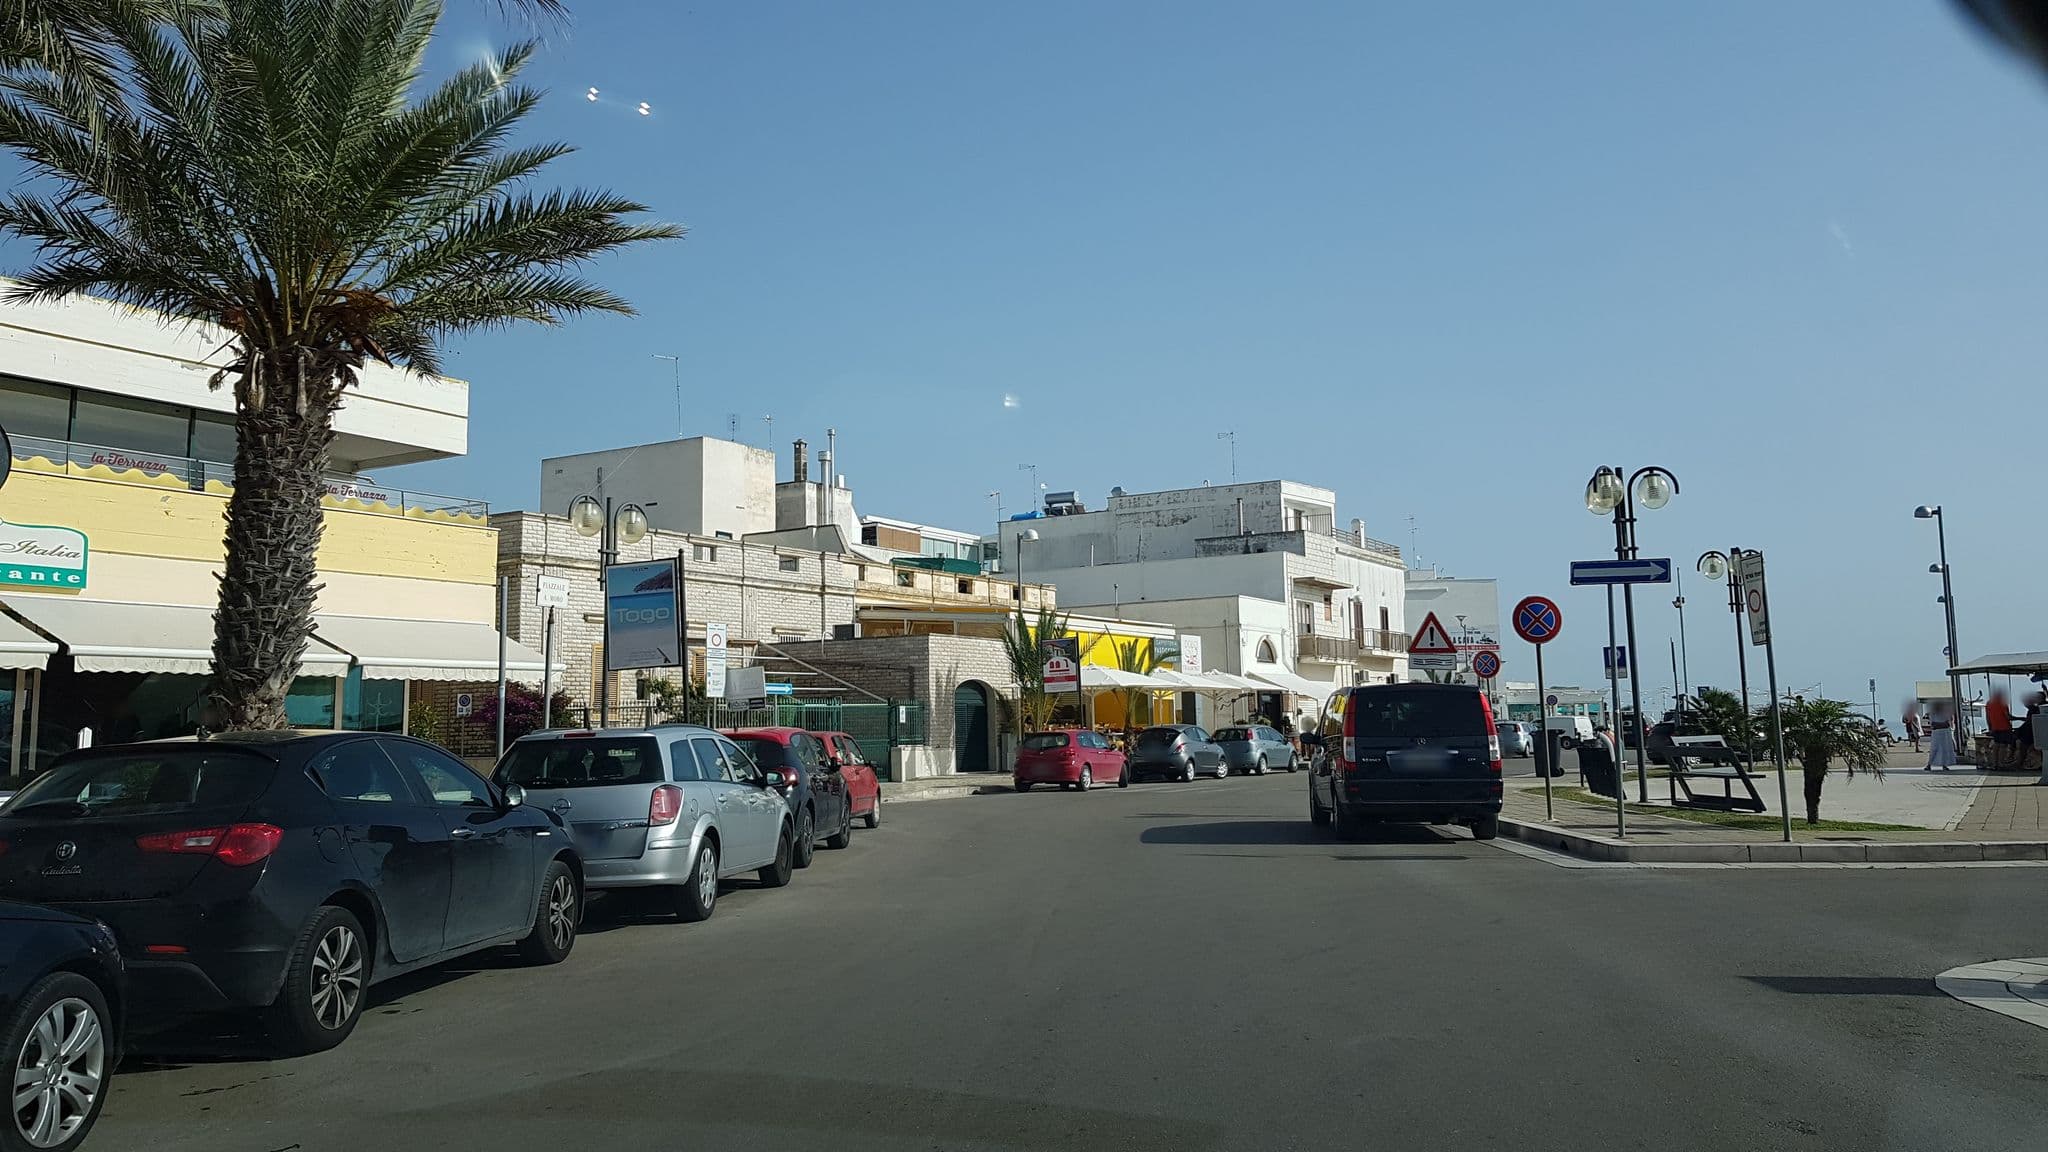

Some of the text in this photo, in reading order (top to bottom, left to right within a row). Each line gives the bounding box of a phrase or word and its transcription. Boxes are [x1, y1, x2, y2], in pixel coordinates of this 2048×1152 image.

[91, 452, 169, 472] la Terrazza
[341, 485, 389, 501] Terrazza
[8, 539, 81, 559] Italia
[0, 569, 81, 583] ante
[614, 607, 670, 624] Togo
